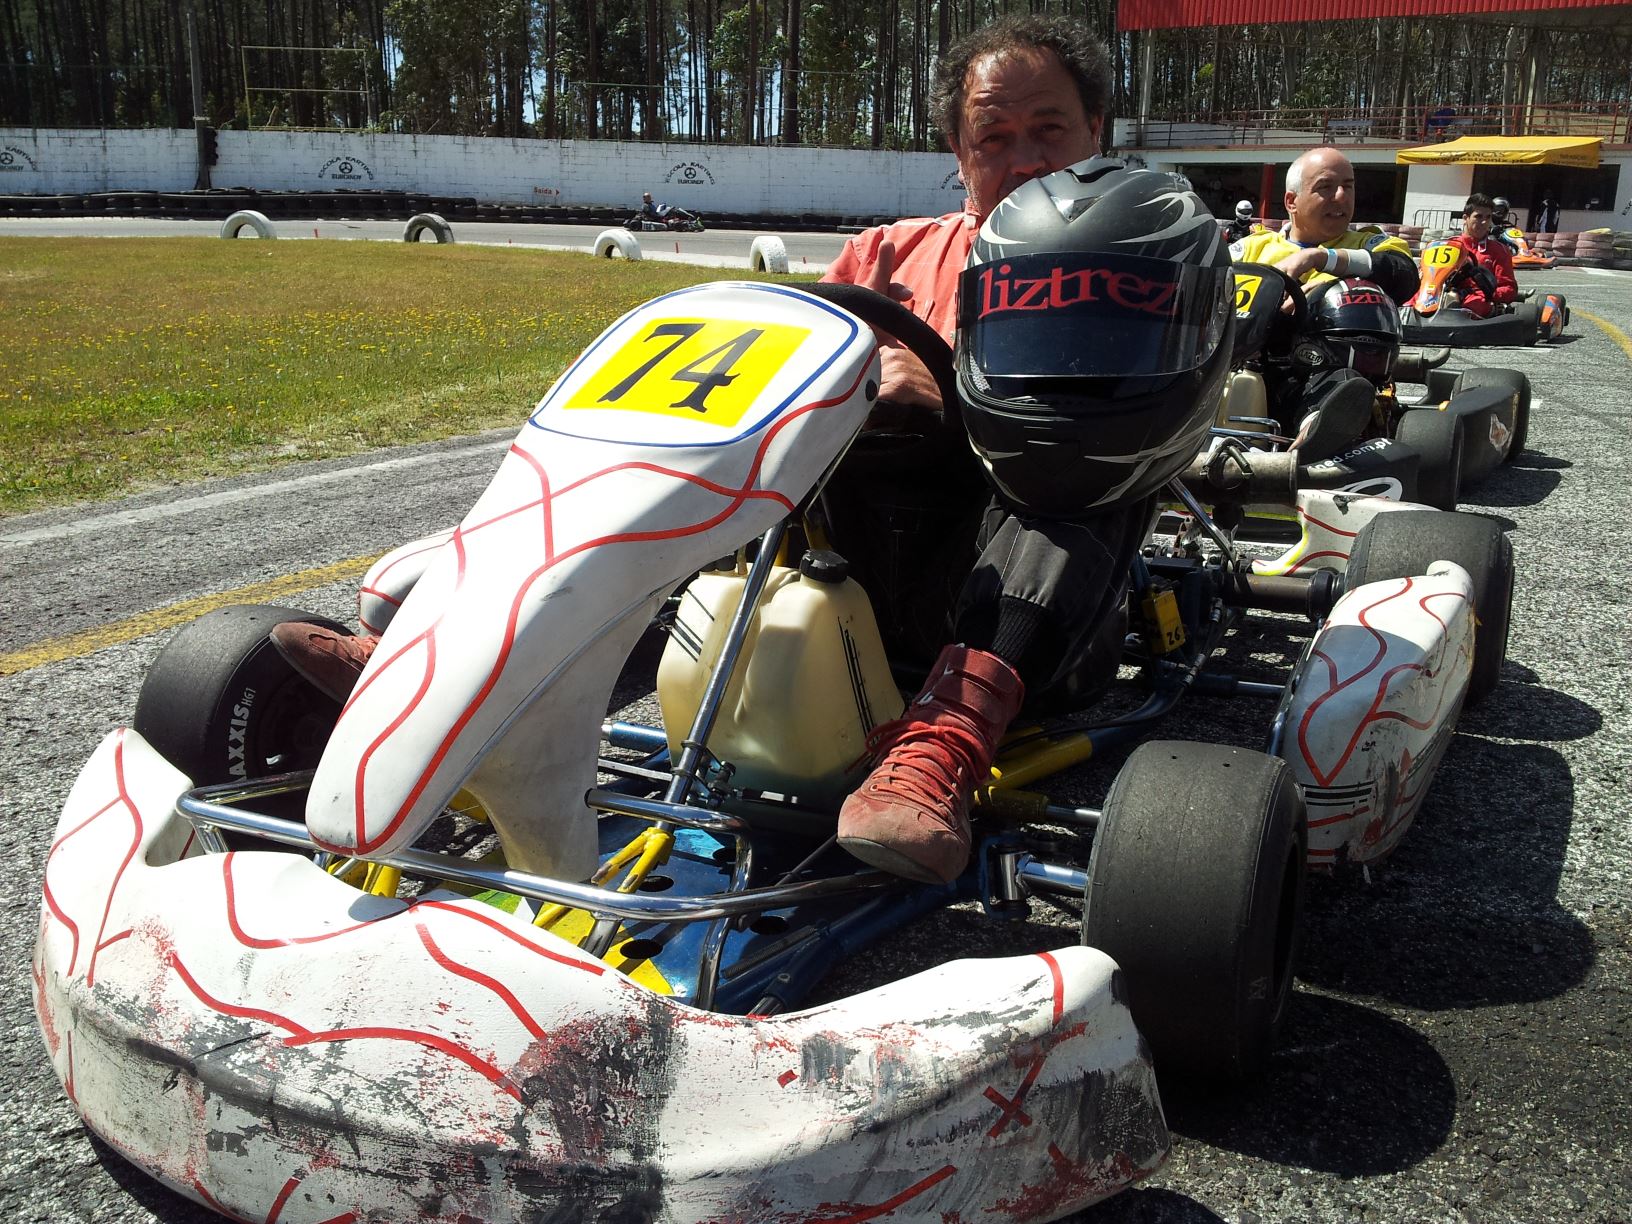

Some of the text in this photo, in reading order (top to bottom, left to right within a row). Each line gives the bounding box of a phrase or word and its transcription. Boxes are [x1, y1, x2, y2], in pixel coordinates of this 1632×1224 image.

[318, 156, 374, 180] ESCOLA KARTING
[665, 162, 716, 185] ESCOLA KARTING
[1430, 247, 1453, 264] 15
[977, 263, 1182, 320] liztrez
[596, 322, 766, 413] 74
[1308, 437, 1393, 470] ned.com.pt
[1166, 626, 1181, 645] 26
[228, 704, 249, 780] AXXIS
